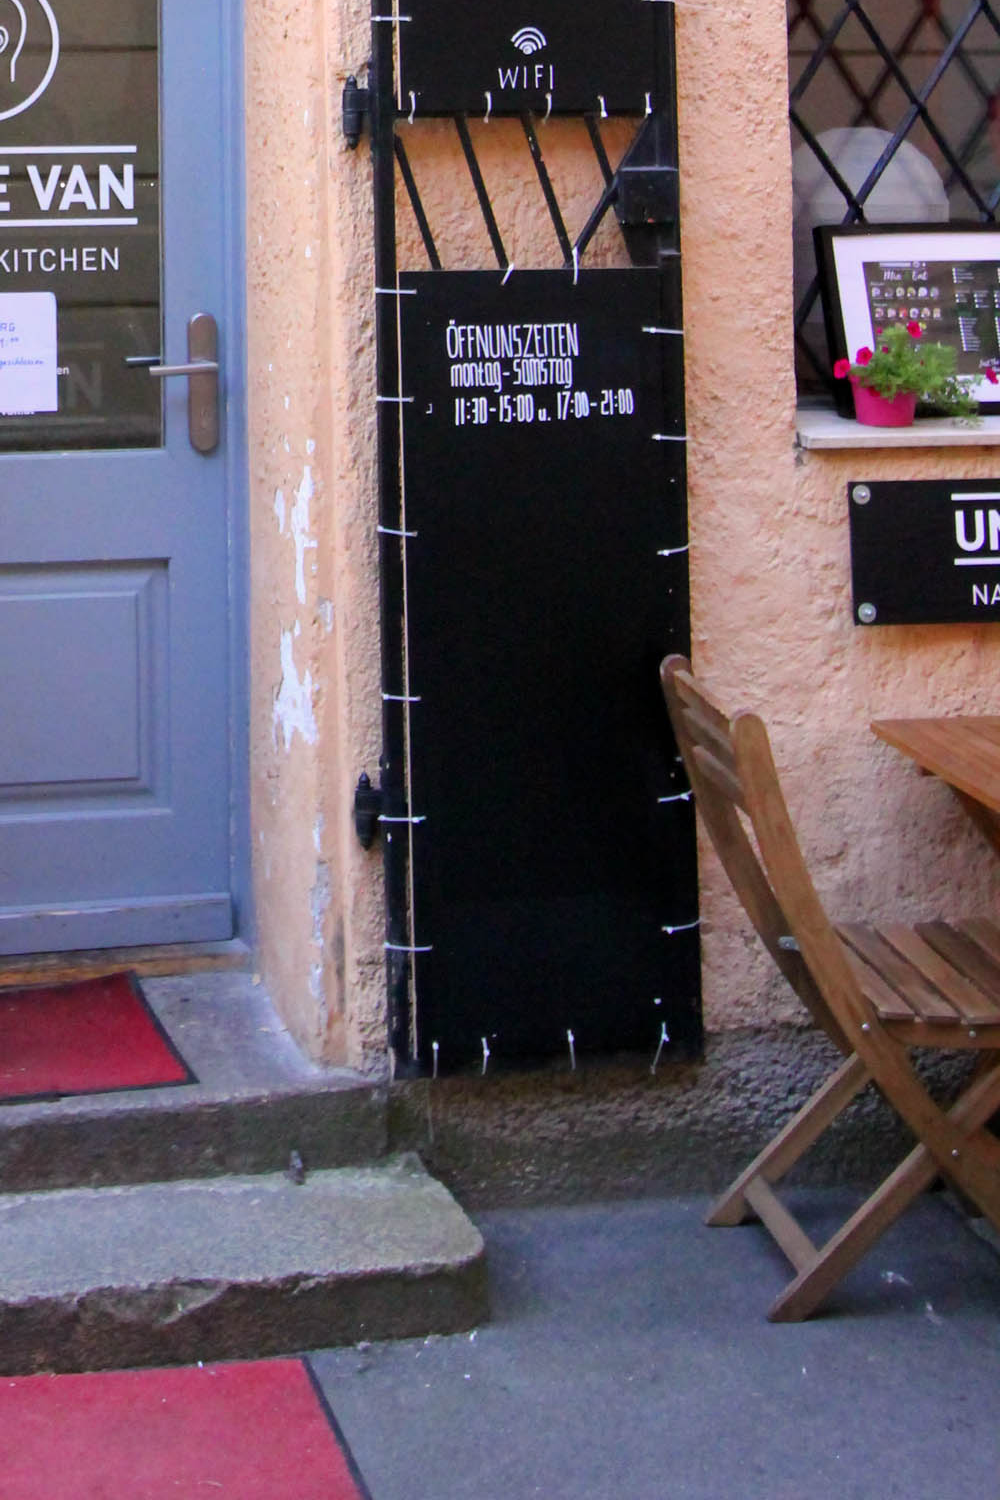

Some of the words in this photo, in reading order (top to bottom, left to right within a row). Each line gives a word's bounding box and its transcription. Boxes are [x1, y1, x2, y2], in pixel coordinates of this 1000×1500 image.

[498, 64, 554, 90] WIFI
[26, 163, 135, 212] VAN
[446, 319, 579, 359] ÖFFNUNSZEITEN
